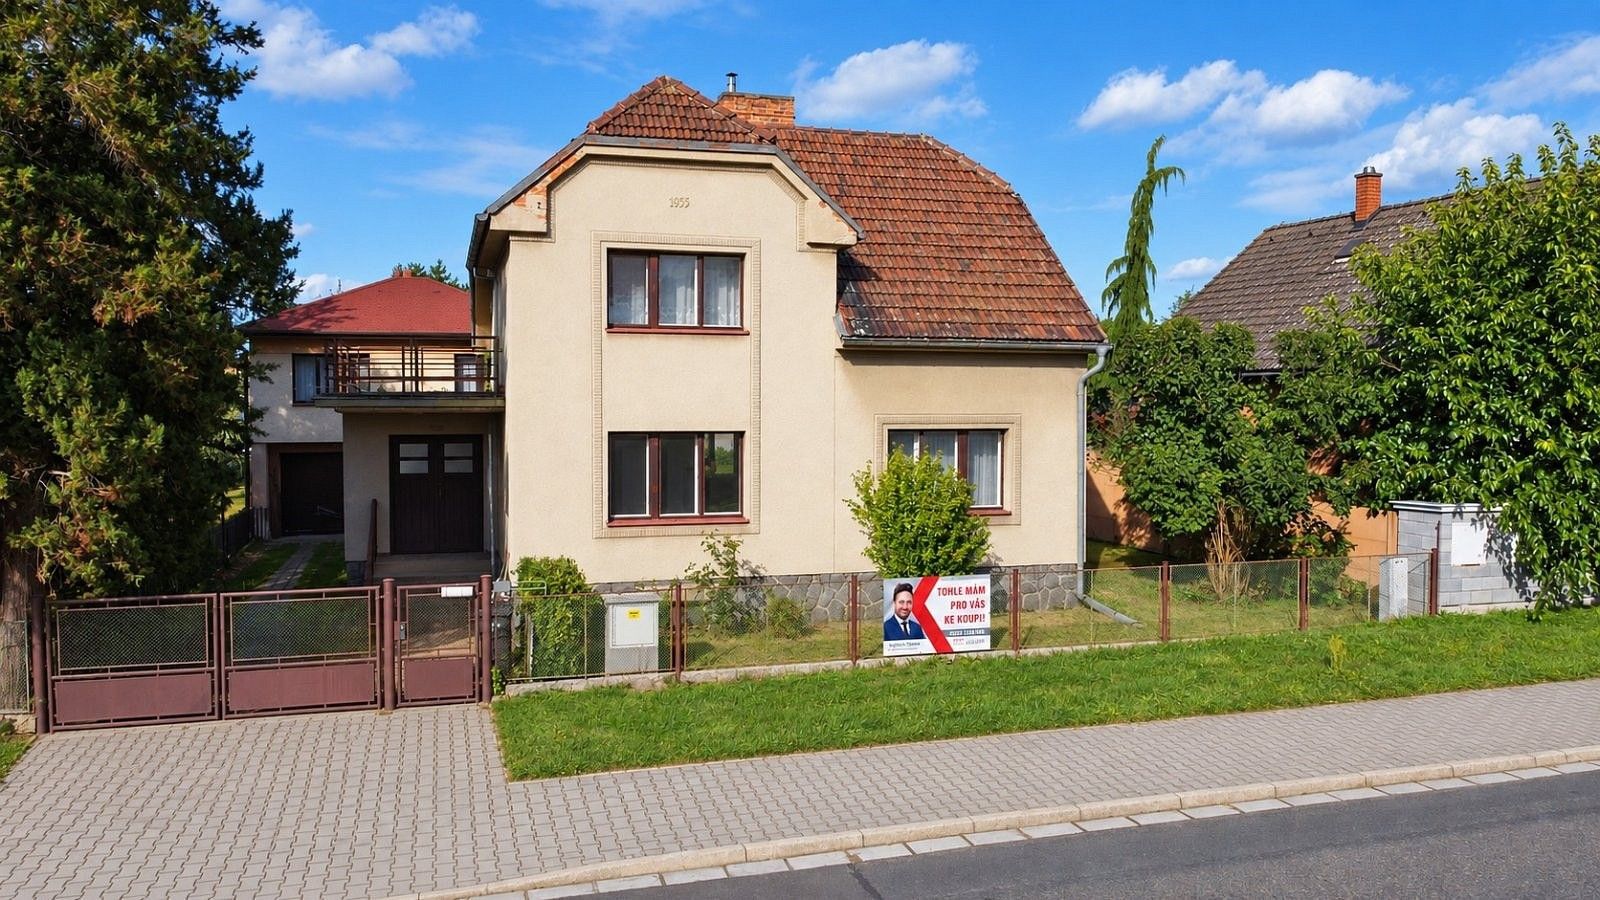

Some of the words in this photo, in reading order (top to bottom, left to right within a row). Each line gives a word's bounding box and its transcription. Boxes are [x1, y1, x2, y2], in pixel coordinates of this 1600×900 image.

[669, 196, 690, 208] 1955
[937, 587, 963, 596] TOHLE
[965, 584, 986, 595] MÁM
[950, 600, 967, 610] PRO
[970, 598, 986, 608] VÁS
[944, 615, 954, 624] KE
[957, 614, 986, 624] KOUPI!
